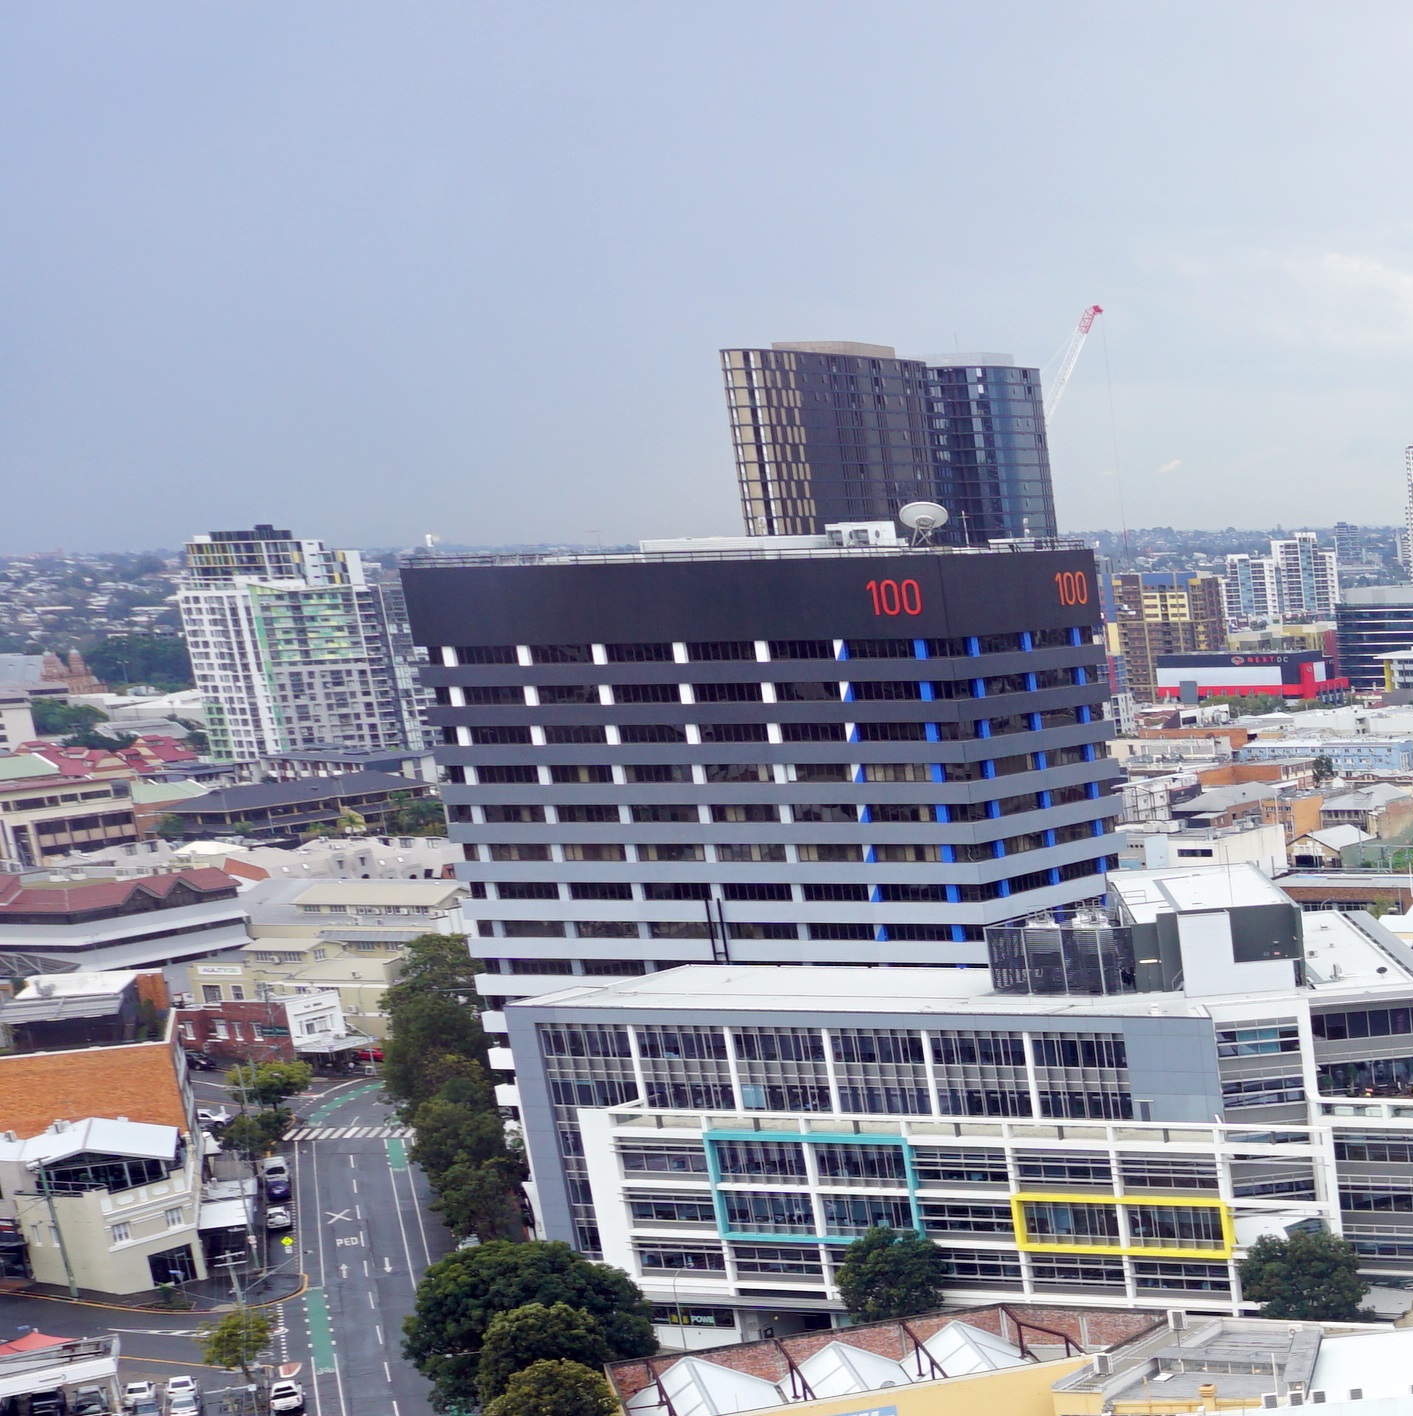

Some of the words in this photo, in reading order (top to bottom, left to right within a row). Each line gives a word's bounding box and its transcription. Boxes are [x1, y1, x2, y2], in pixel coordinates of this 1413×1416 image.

[867, 578, 923, 616] 100
[1054, 571, 1088, 606] 100
[335, 1237, 359, 1248] PED
